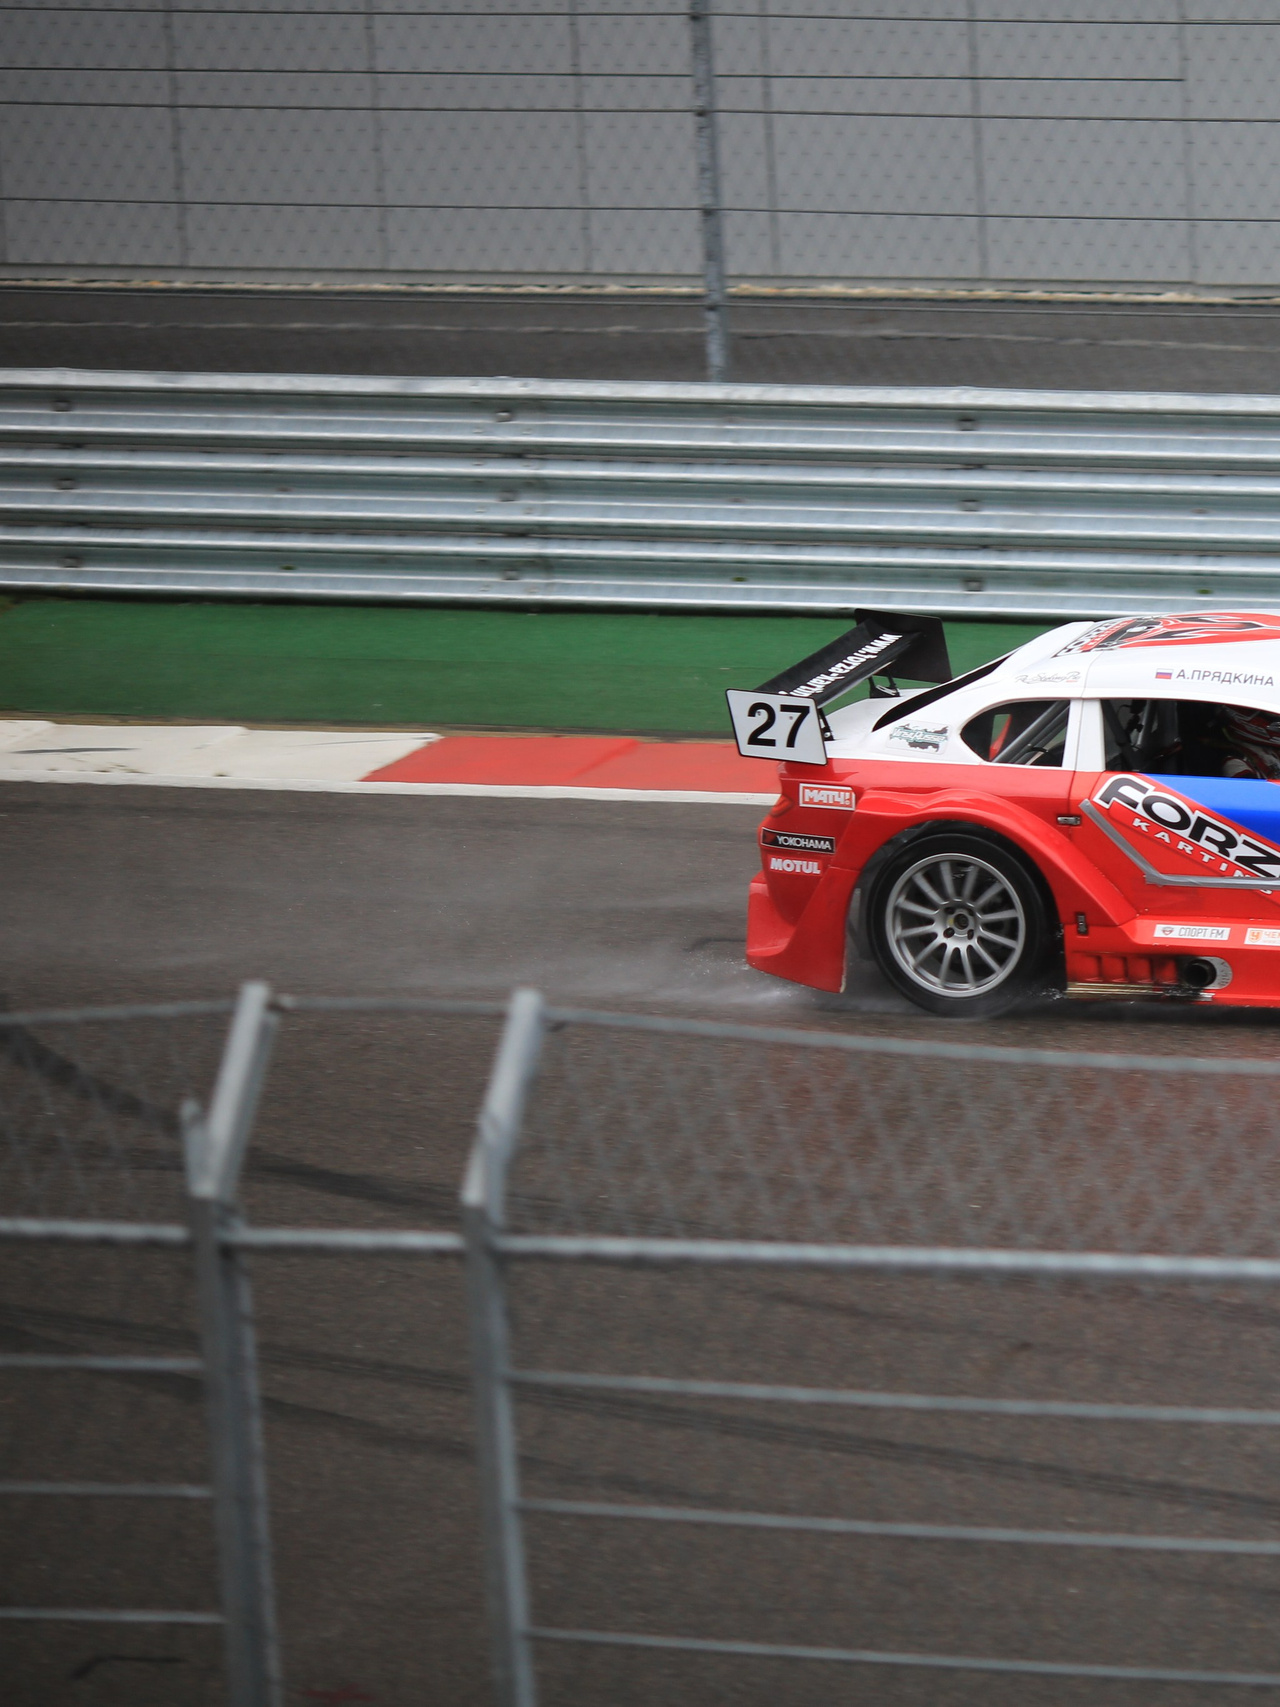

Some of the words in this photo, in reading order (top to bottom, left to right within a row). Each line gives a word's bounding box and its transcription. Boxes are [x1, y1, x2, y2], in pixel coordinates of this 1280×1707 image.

[1176, 669, 1274, 686] А.ПРЯДКИНА
[747, 702, 810, 748] 27
[804, 788, 851, 805] МАТЧ!
[776, 836, 832, 850] YOKOHAMA
[1132, 818, 1272, 895] KARTI
[770, 857, 821, 874] MOTUL
[1178, 927, 1207, 938] СПОРТ
[1209, 929, 1225, 938] FM
